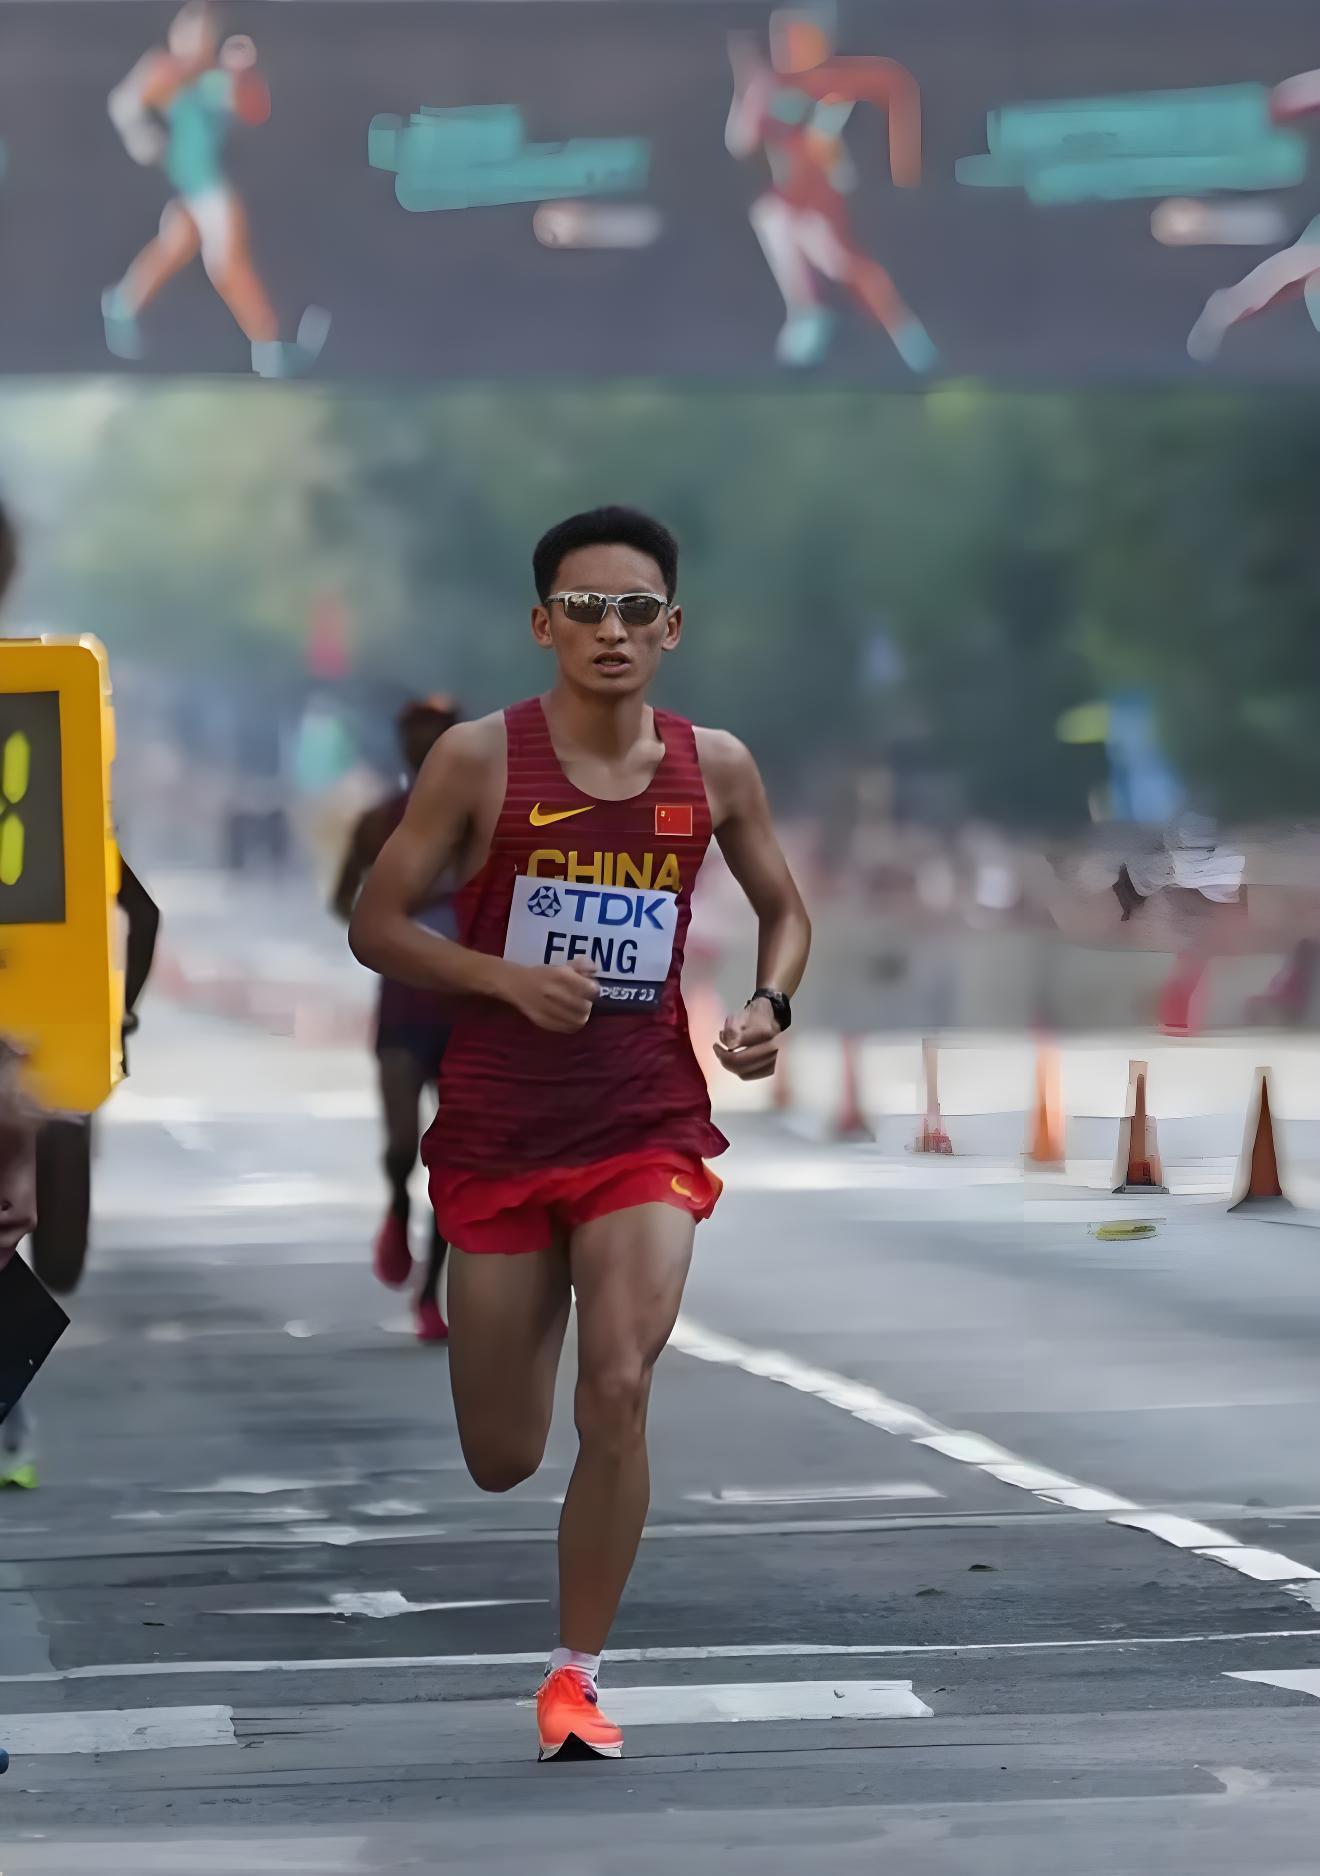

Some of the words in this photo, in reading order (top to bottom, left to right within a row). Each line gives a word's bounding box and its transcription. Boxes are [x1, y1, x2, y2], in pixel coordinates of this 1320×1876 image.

[527, 849, 683, 893] CHINA
[564, 889, 667, 930] TDK
[544, 931, 638, 974] FENG
